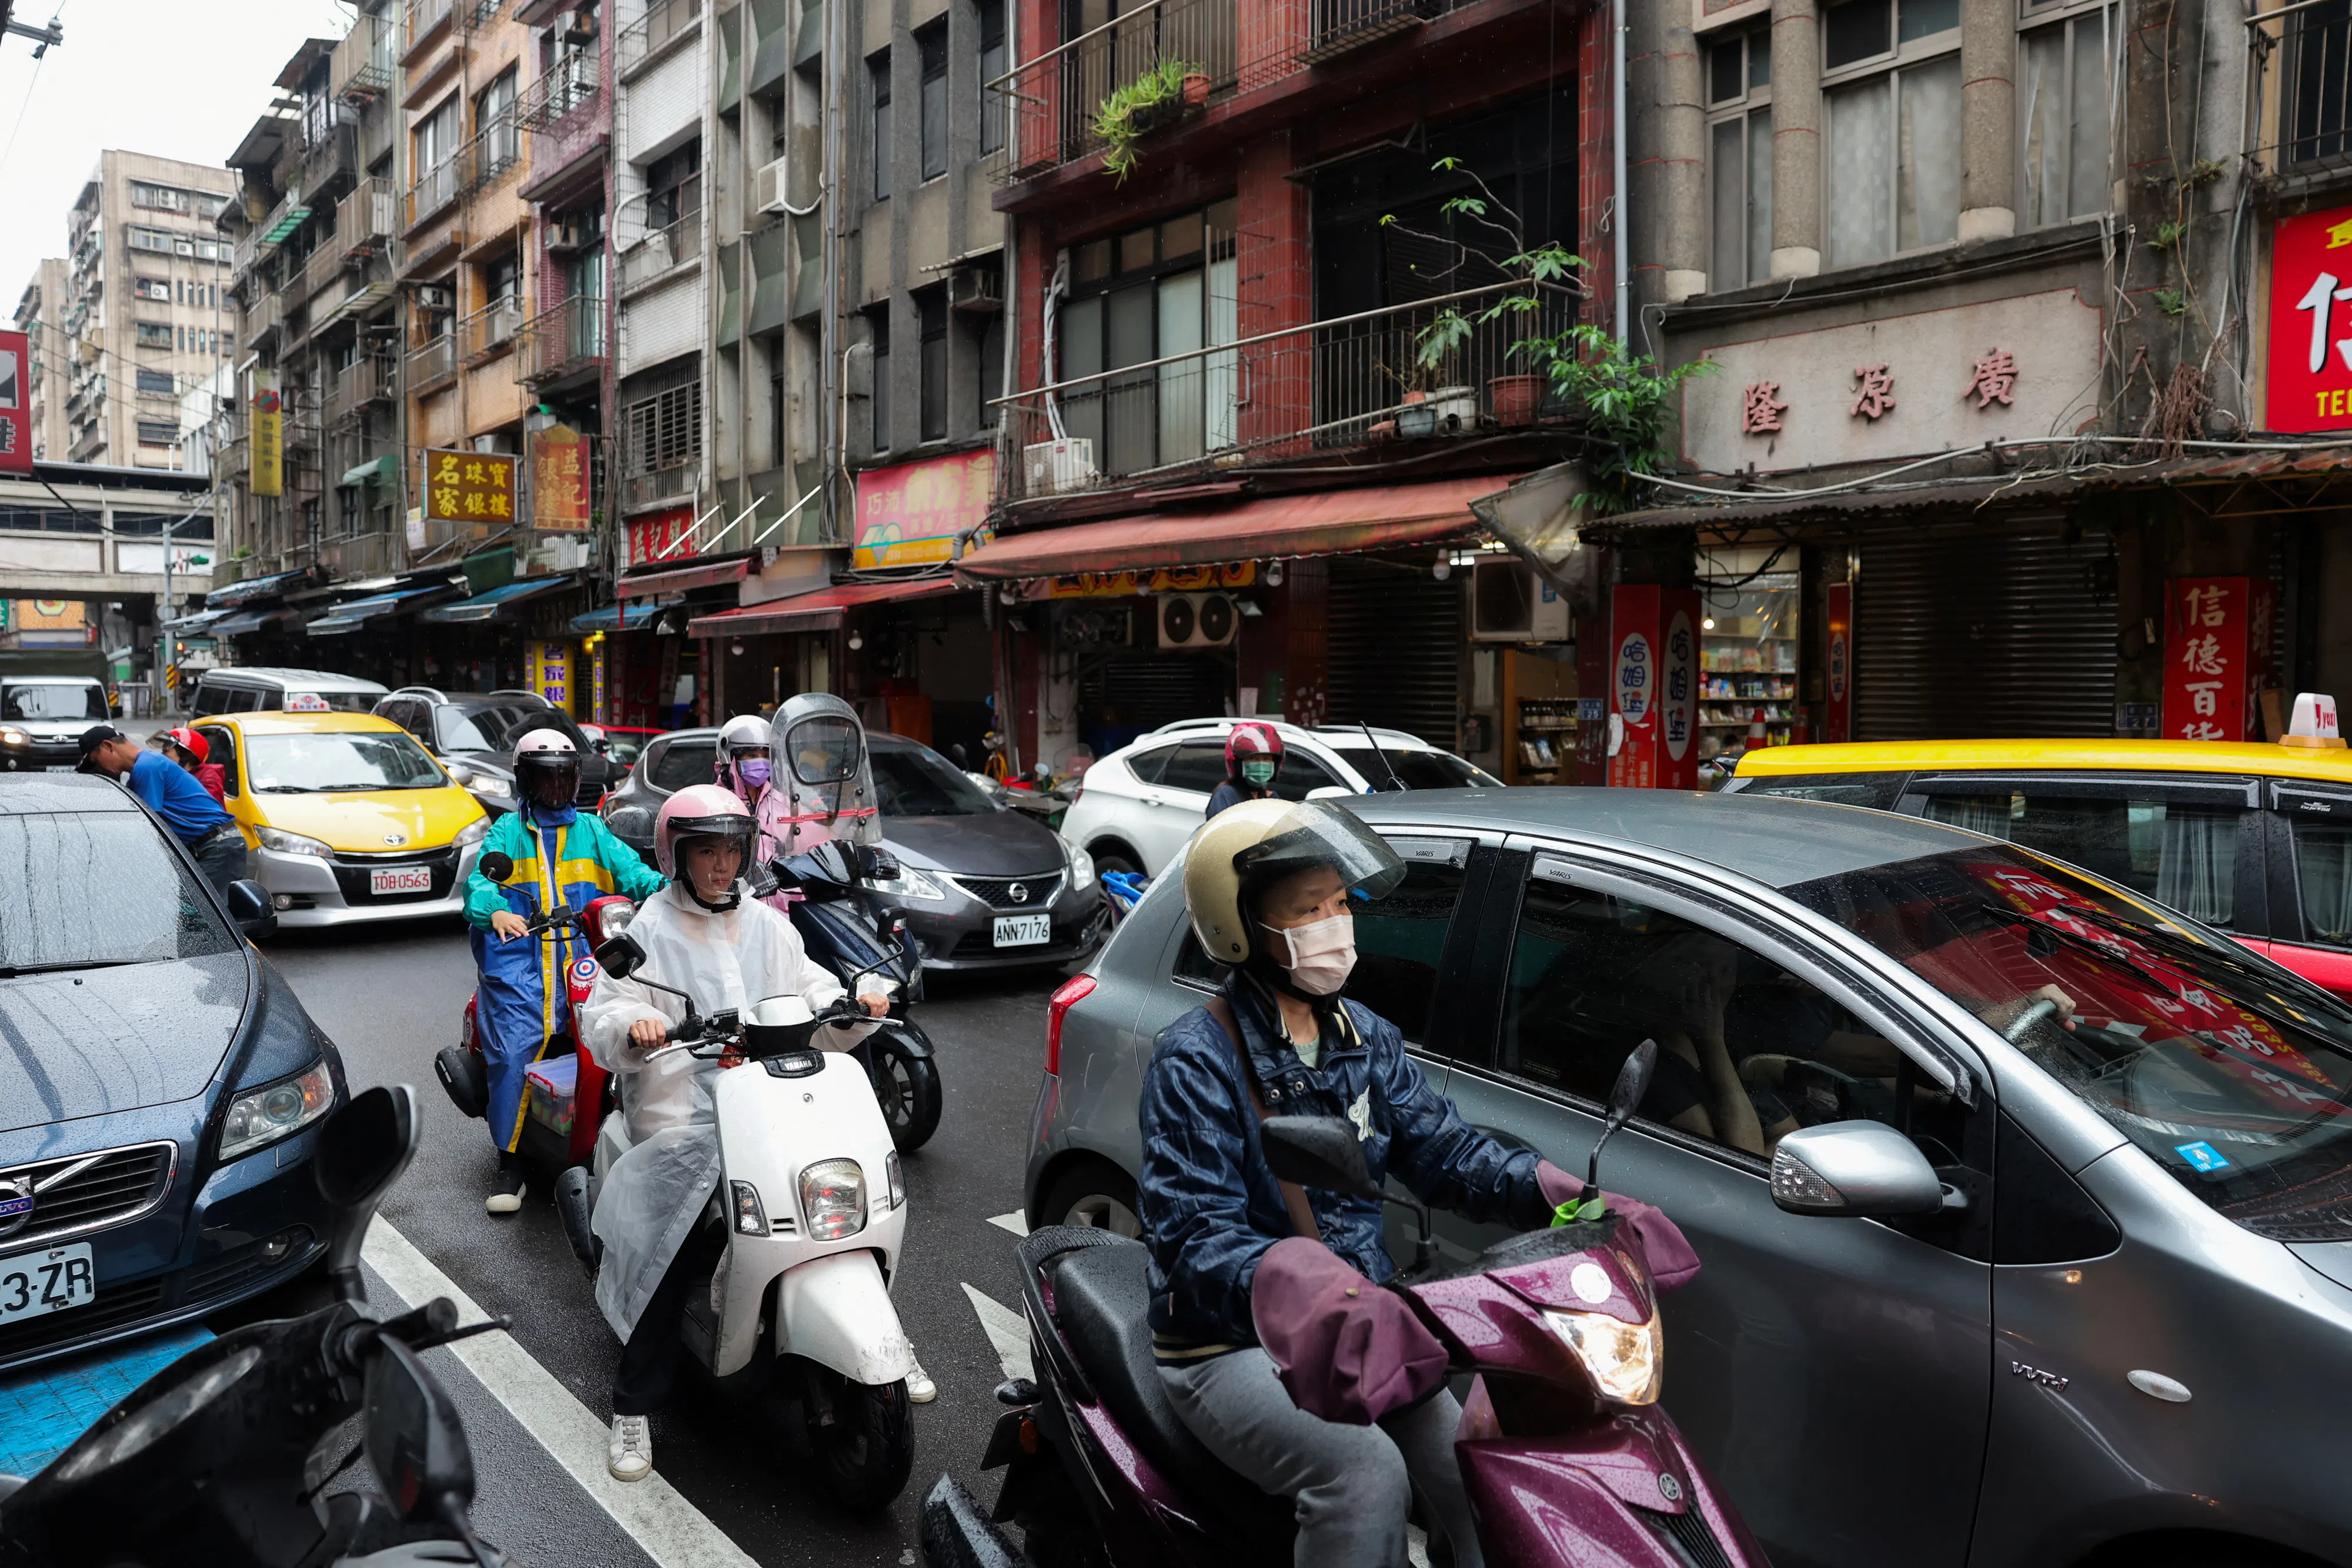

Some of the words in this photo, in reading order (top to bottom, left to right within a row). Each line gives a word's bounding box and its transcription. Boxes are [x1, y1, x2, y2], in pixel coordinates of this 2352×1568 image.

[433, 454, 460, 517] 名家
[543, 645, 566, 712] 名家銀
[2323, 706, 2336, 730] yoxi
[372, 872, 430, 890] TDB-0563
[995, 921, 1050, 943] ANN-7176
[784, 1059, 813, 1071] YAMAHA
[0, 1258, 92, 1315] 3-ZR
